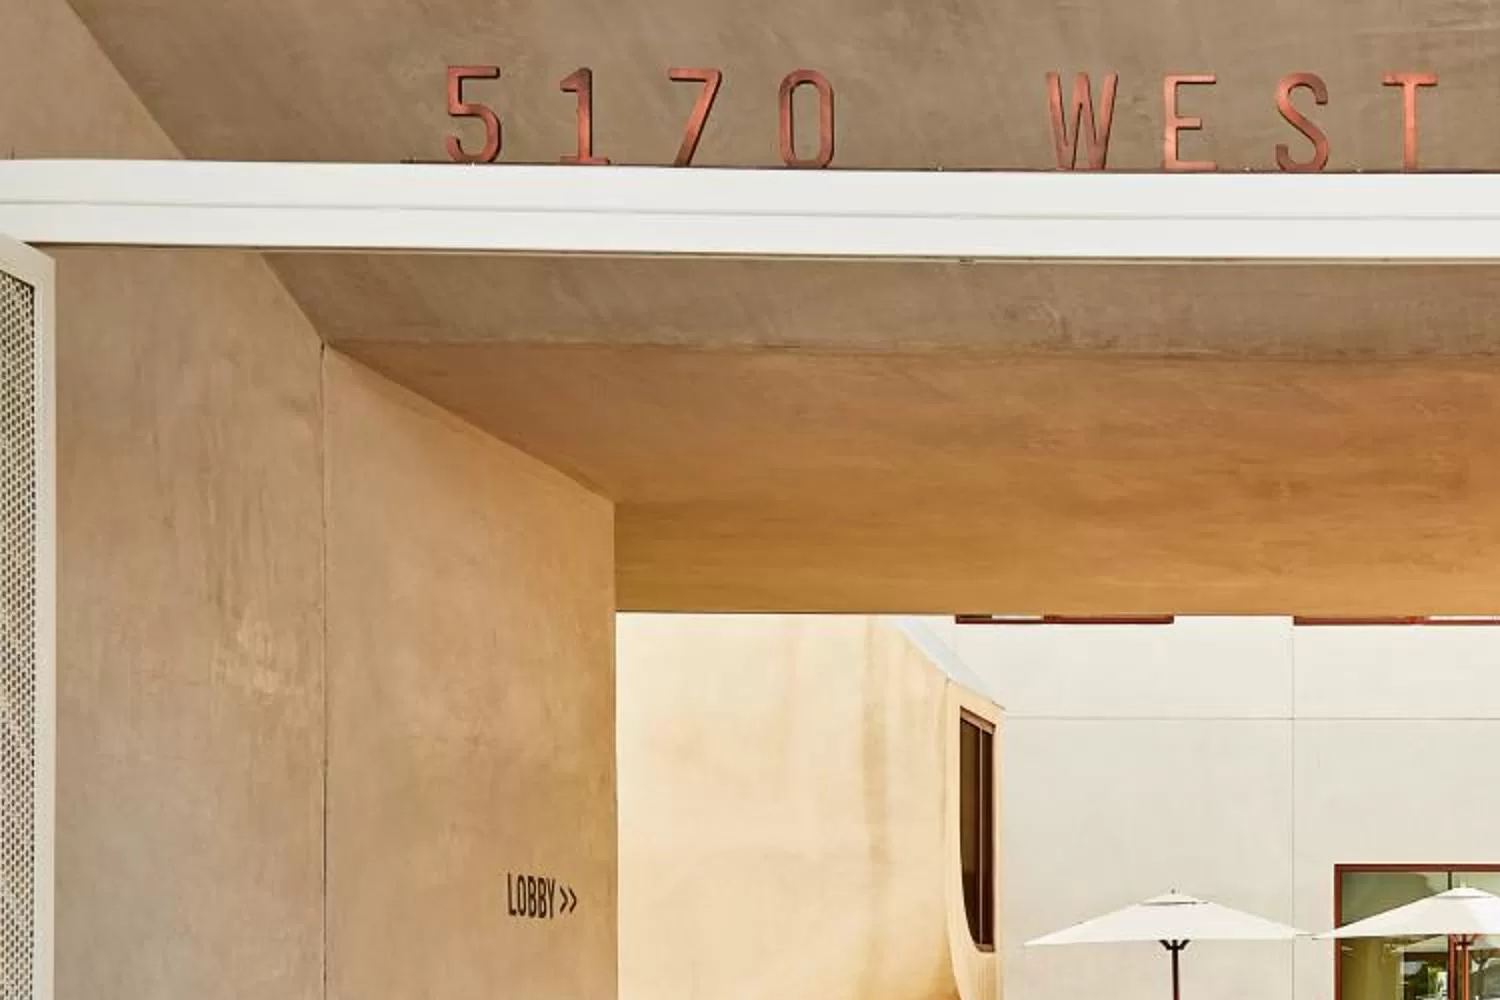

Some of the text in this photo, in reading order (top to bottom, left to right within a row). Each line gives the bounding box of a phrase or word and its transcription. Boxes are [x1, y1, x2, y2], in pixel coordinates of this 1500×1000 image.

[447, 66, 834, 168] 5170
[1046, 72, 1438, 172] WEST
[507, 872, 556, 920] LOBBY
